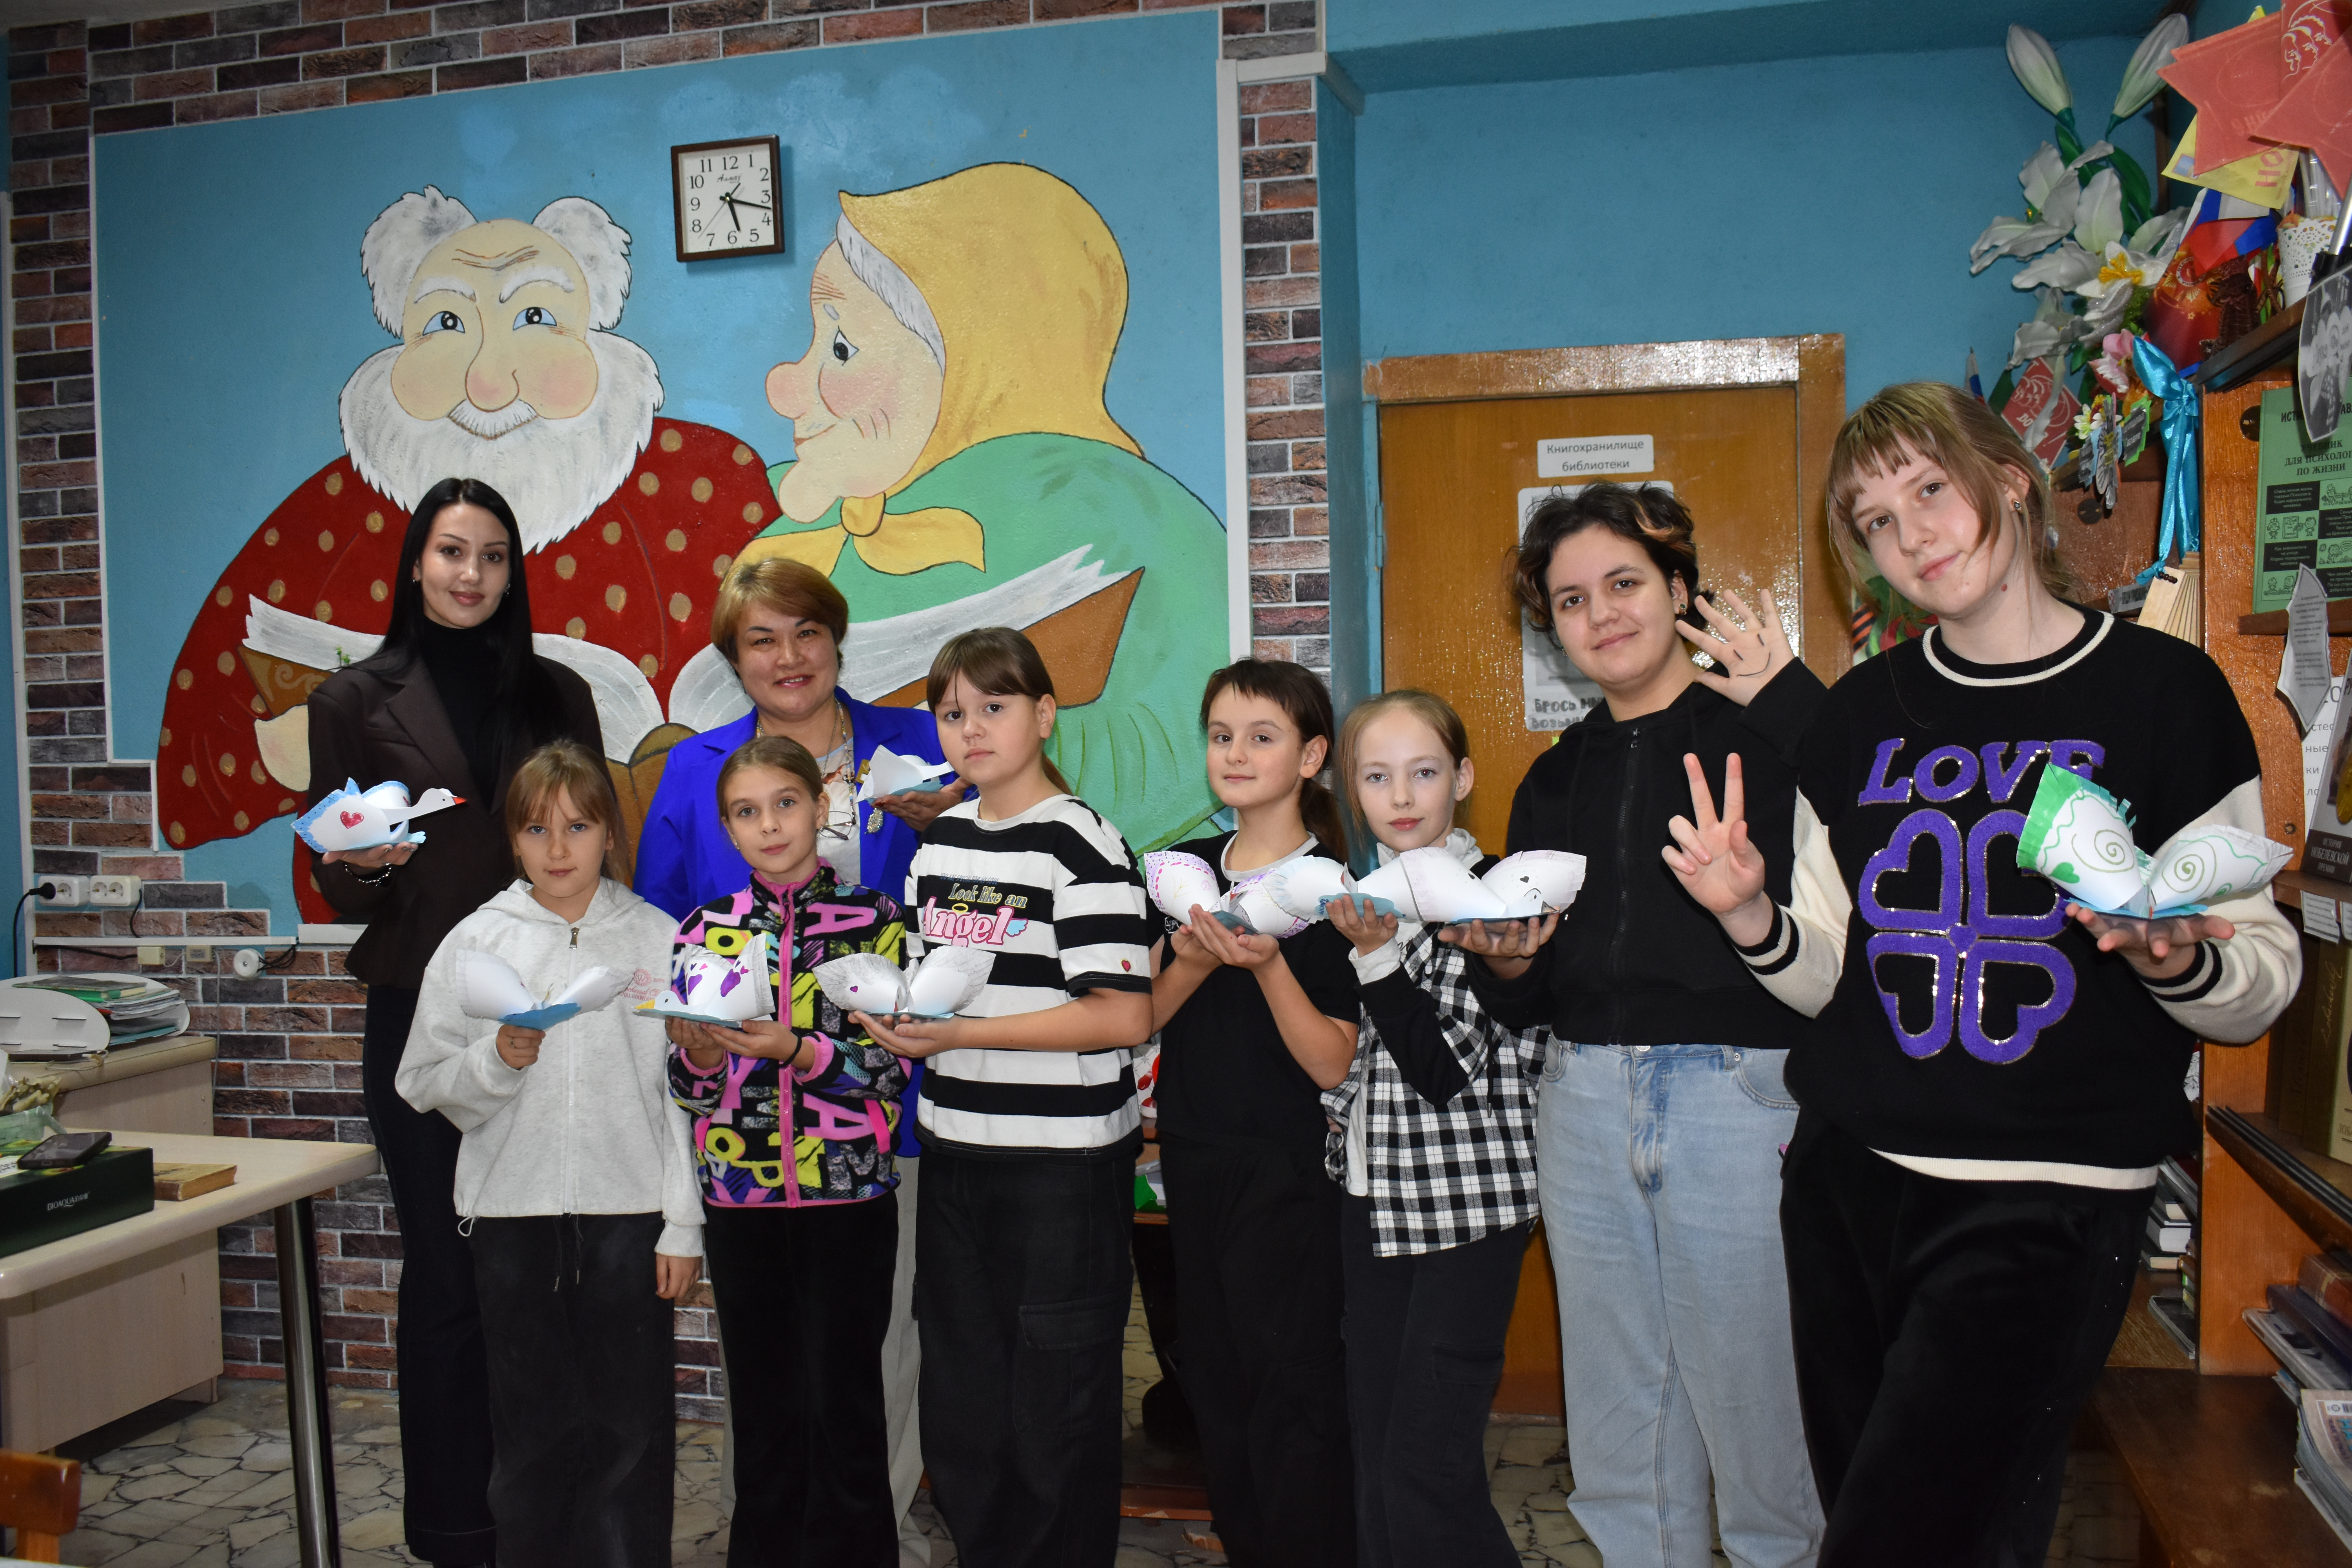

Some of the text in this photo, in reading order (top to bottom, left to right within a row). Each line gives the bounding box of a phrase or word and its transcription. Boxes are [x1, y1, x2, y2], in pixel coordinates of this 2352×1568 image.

[701, 158, 712, 172] 11
[723, 156, 739, 171] 12
[749, 154, 754, 168] 1
[760, 167, 769, 181] 2
[690, 175, 704, 189] 10
[761, 189, 771, 203] 3
[690, 197, 700, 211] 9
[692, 219, 701, 233] 8
[762, 212, 772, 226] 4
[706, 233, 715, 247] 7
[727, 230, 737, 244] 6
[750, 229, 760, 242] 5
[1547, 441, 1644, 454] Книгохранилище
[1562, 460, 1630, 472] библиотеки
[2284, 456, 2302, 466] ДЛЯ
[2296, 463, 2346, 475] ПО ЖИЗНИ
[1535, 698, 1576, 713] БРОСЬ
[1858, 737, 2105, 806] LOVE
[2311, 846, 2350, 866] НОБЕЛЕВСКОЙ
[948, 883, 1028, 909] Look like an
[923, 896, 1014, 948] Angel
[2337, 1124, 2352, 1136] ЛОБ
